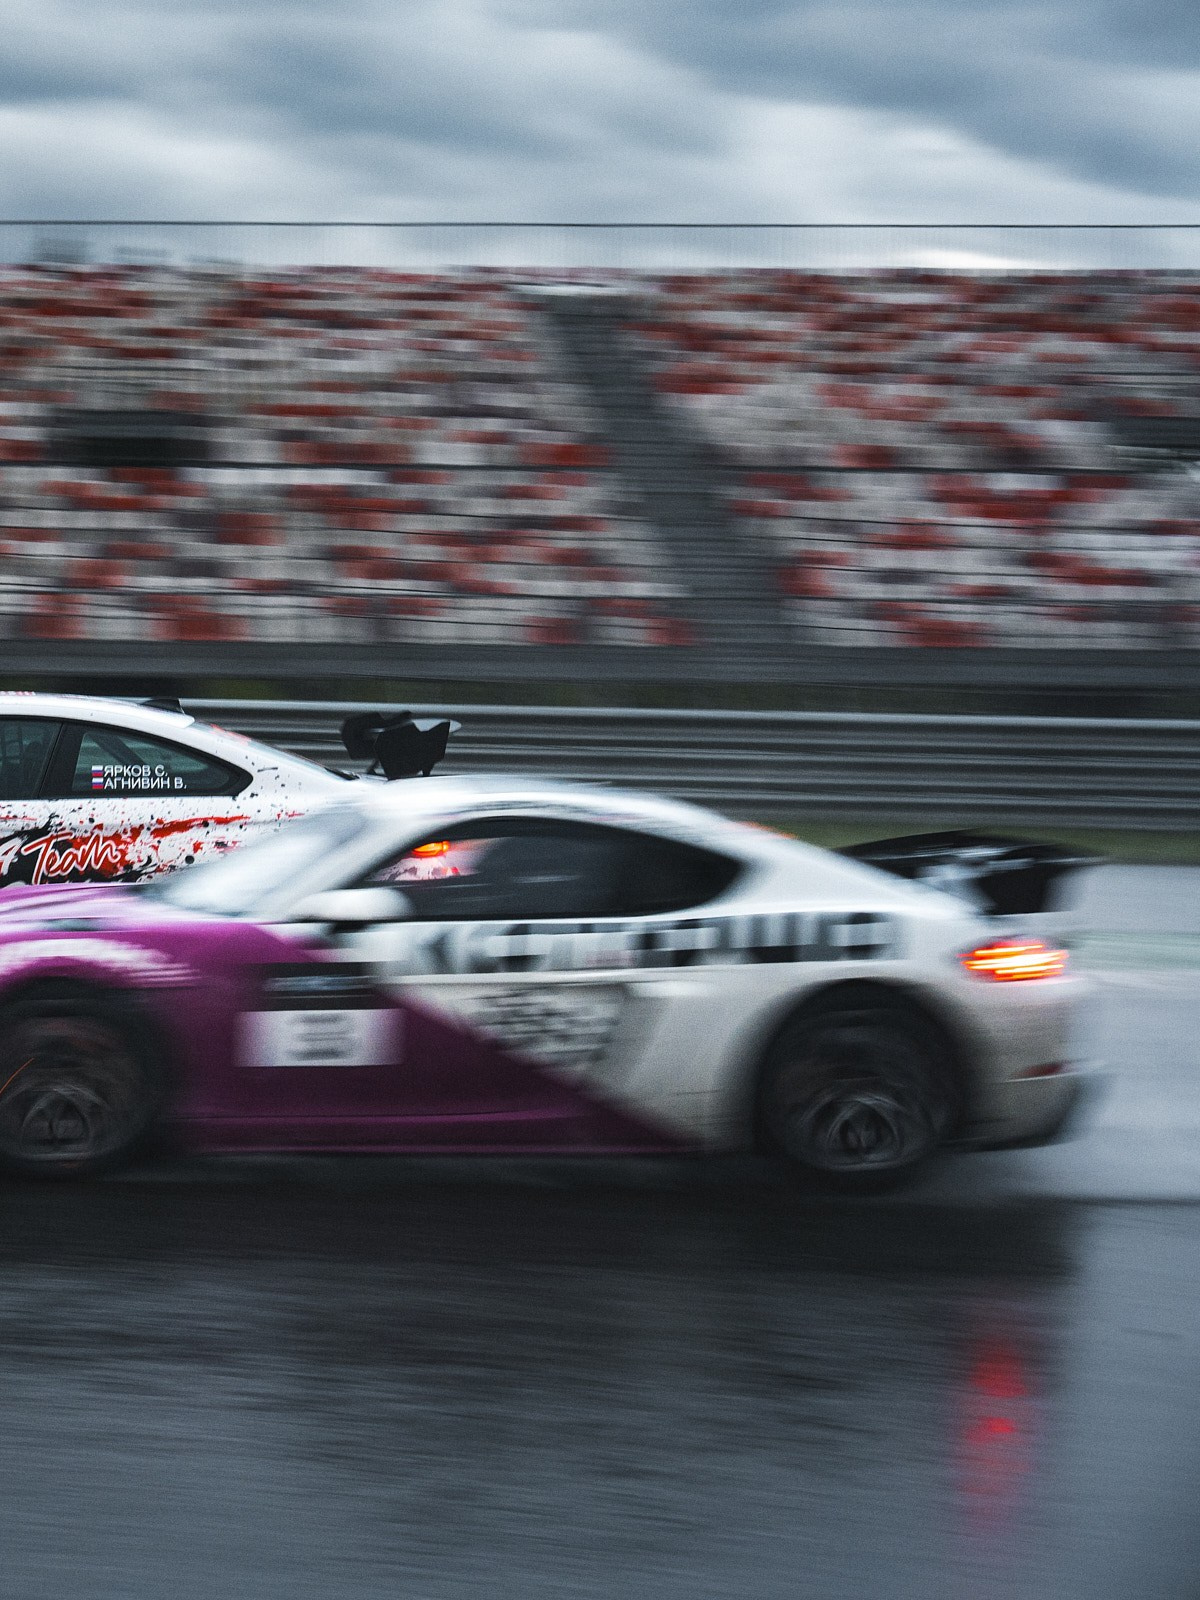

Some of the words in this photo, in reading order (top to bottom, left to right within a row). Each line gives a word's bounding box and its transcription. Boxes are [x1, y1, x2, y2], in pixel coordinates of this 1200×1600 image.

[103, 764, 151, 777] ЯРКОВ
[103, 777, 170, 789] АГНИВИН
[20, 830, 122, 885] Team
